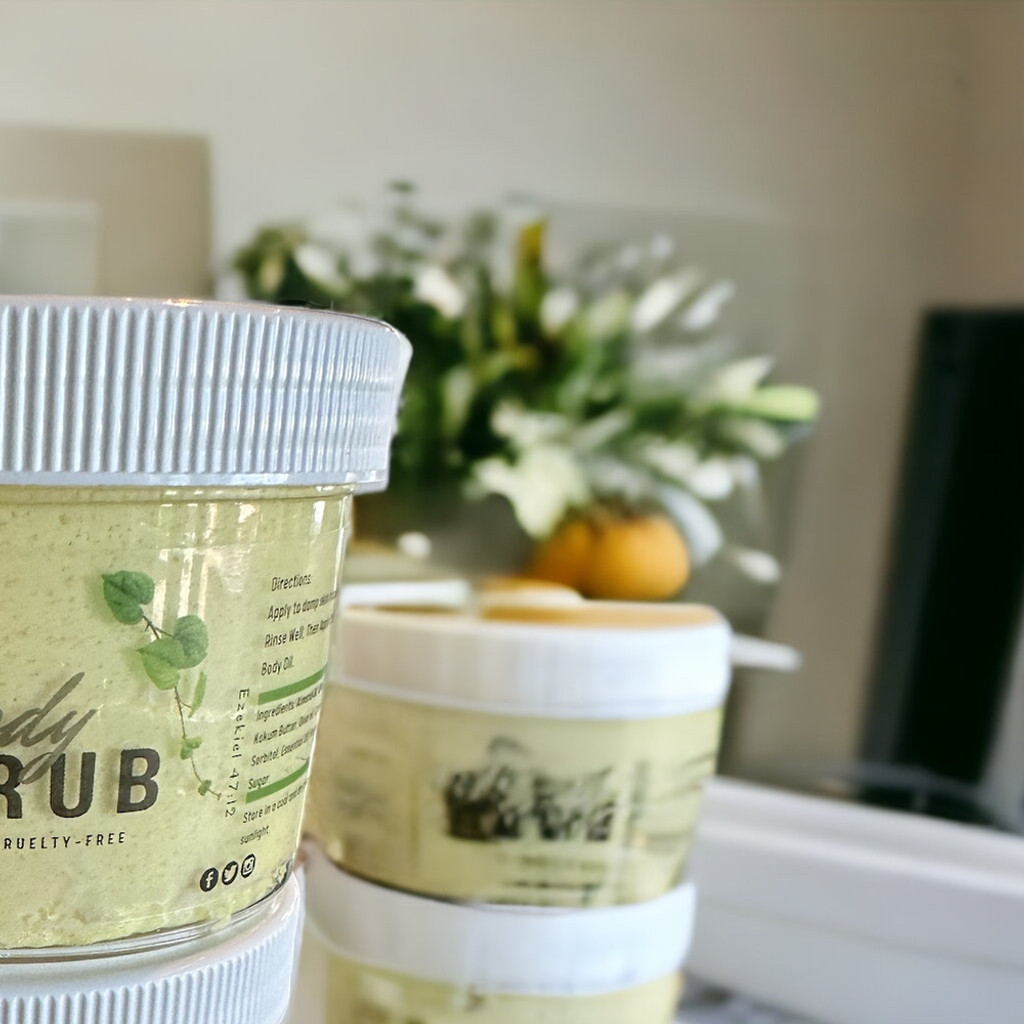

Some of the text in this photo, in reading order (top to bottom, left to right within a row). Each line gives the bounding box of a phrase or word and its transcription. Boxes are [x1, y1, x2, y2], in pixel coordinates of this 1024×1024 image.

[267, 603, 292, 622] Apply
[293, 602, 302, 615] to
[264, 633, 287, 648] Rinse
[261, 658, 282, 677] Body
[253, 729, 278, 744] Kokum
[225, 688, 250, 818] Ezekiel 47:12
[248, 775, 270, 791] Sugar
[242, 808, 263, 824] Store
[240, 825, 270, 845] sunlight
